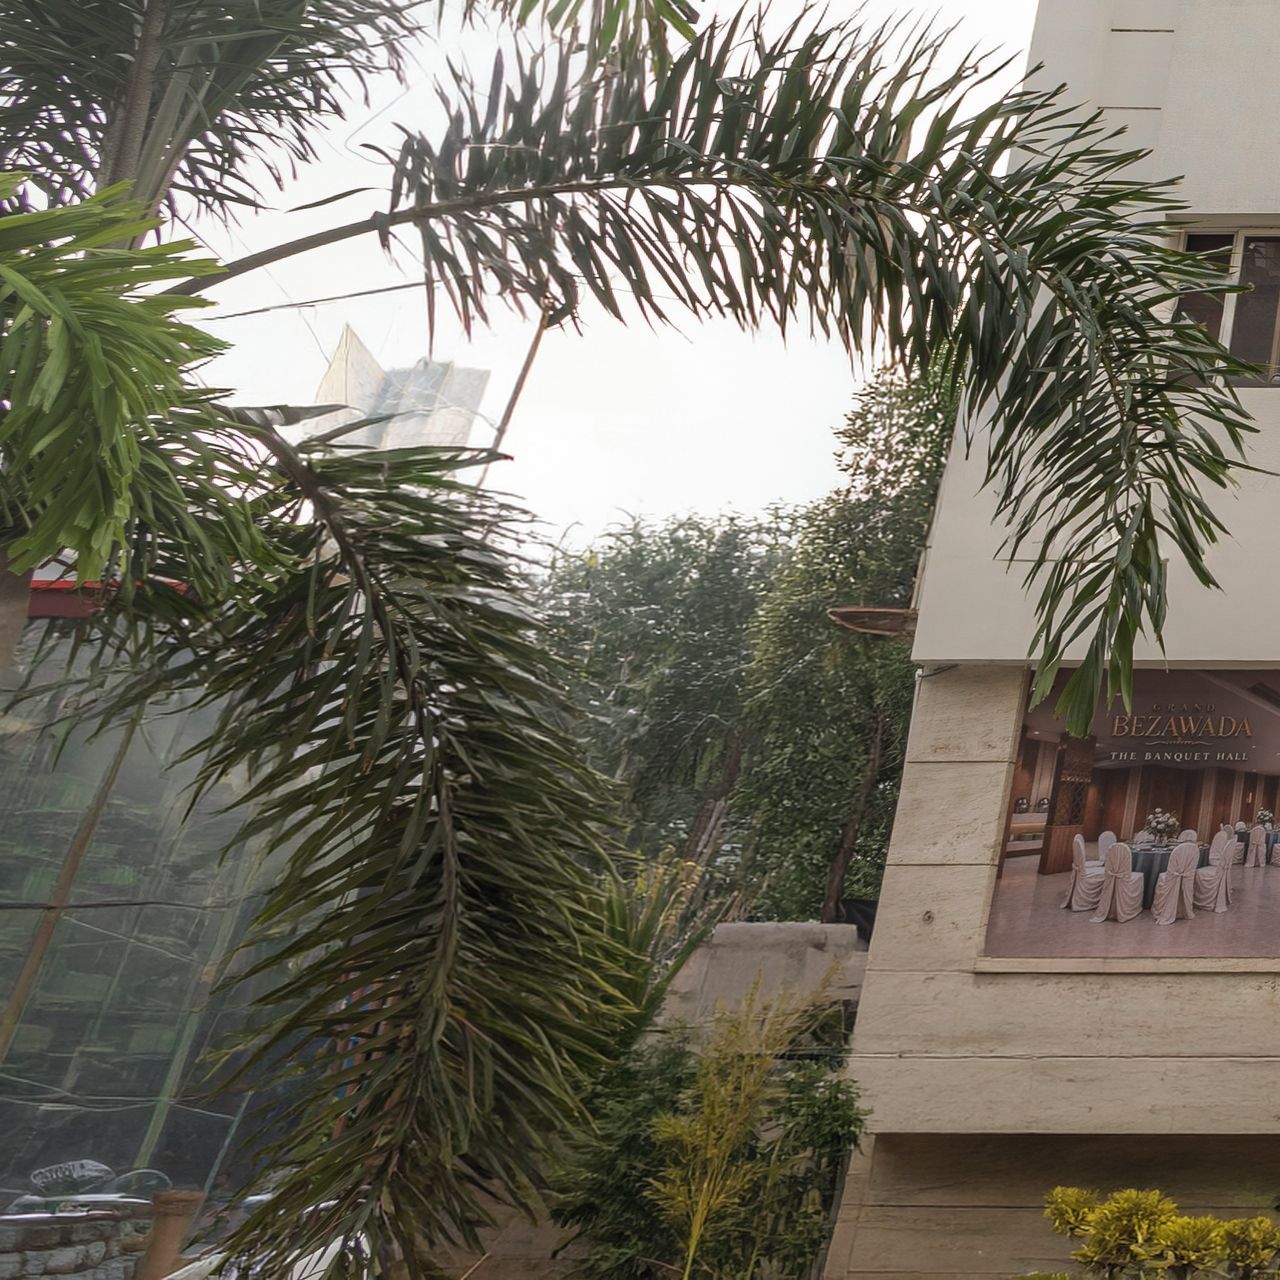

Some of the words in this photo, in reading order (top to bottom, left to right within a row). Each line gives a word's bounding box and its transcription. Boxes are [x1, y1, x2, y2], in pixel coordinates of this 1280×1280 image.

[1152, 703, 1217, 713] GRAND
[1111, 715, 1254, 738] BEZAWADA
[1110, 751, 1137, 761] THE
[1144, 751, 1211, 762] BANQUET
[1216, 751, 1249, 761] HALL
